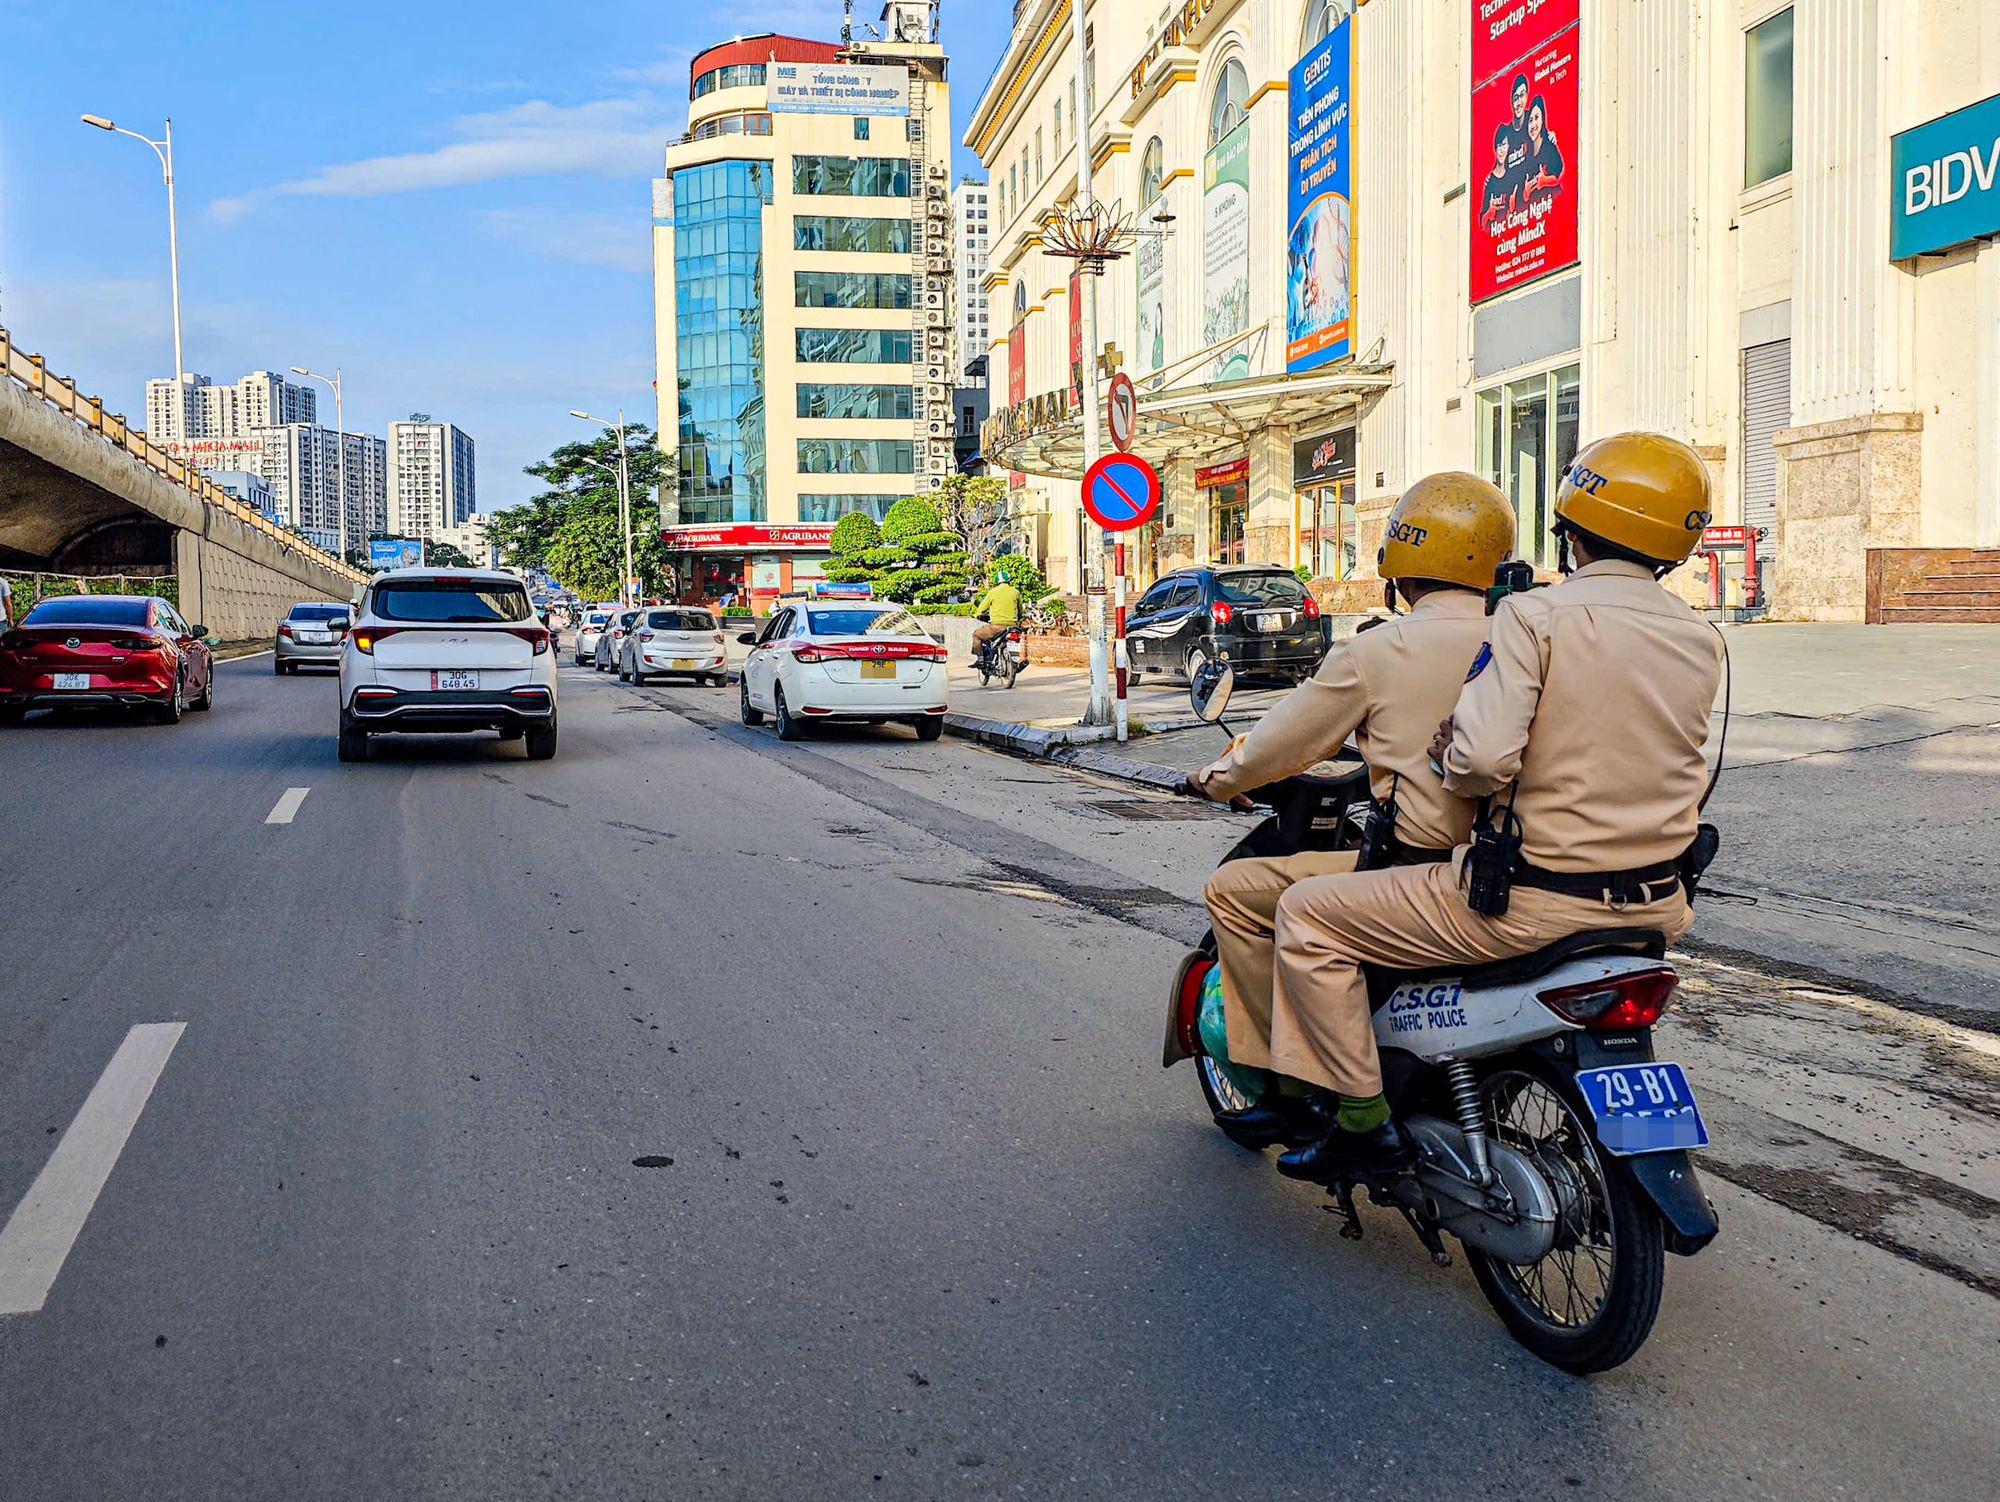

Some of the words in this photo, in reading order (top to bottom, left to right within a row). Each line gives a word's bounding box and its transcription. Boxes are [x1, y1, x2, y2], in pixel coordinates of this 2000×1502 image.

[1490, 5, 1525, 41] Startup
[777, 66, 797, 76] MIE
[1304, 48, 1331, 86] GENTIS
[1555, 68, 1567, 81] Tech
[836, 75, 860, 85] CÔNG
[845, 87, 868, 98] CÔNG
[1298, 105, 1313, 130] TIÊN
[1314, 85, 1339, 118] PHONG
[1290, 129, 1314, 158] TRONG
[1314, 114, 1331, 142] LĨNH
[1332, 101, 1348, 126] VỰC
[1300, 147, 1320, 174] PHÂN
[1320, 133, 1338, 158] TÍCH
[1300, 176, 1309, 195] DI
[1309, 155, 1337, 188] TRUYỀN
[1905, 136, 2000, 216] BIDV
[1491, 221, 1506, 238] Học
[1508, 208, 1529, 229] Công
[1530, 194, 1553, 221] Nghệ
[1496, 237, 1517, 256] cùng
[1518, 220, 1546, 246] MindX
[683, 533, 722, 543] AGRIBANK
[781, 532, 832, 541] AGRIBANK
[1705, 529, 1721, 538] CẤM
[1733, 530, 1742, 538] XE
[441, 679, 475, 689] 648.45
[449, 671, 467, 680] 30G
[1389, 1013, 1423, 1033] TRAFFIC
[1427, 1008, 1468, 1030] POLICE
[1603, 1037, 1638, 1045] HONDA
[1596, 1067, 1678, 1108] 29-B1
